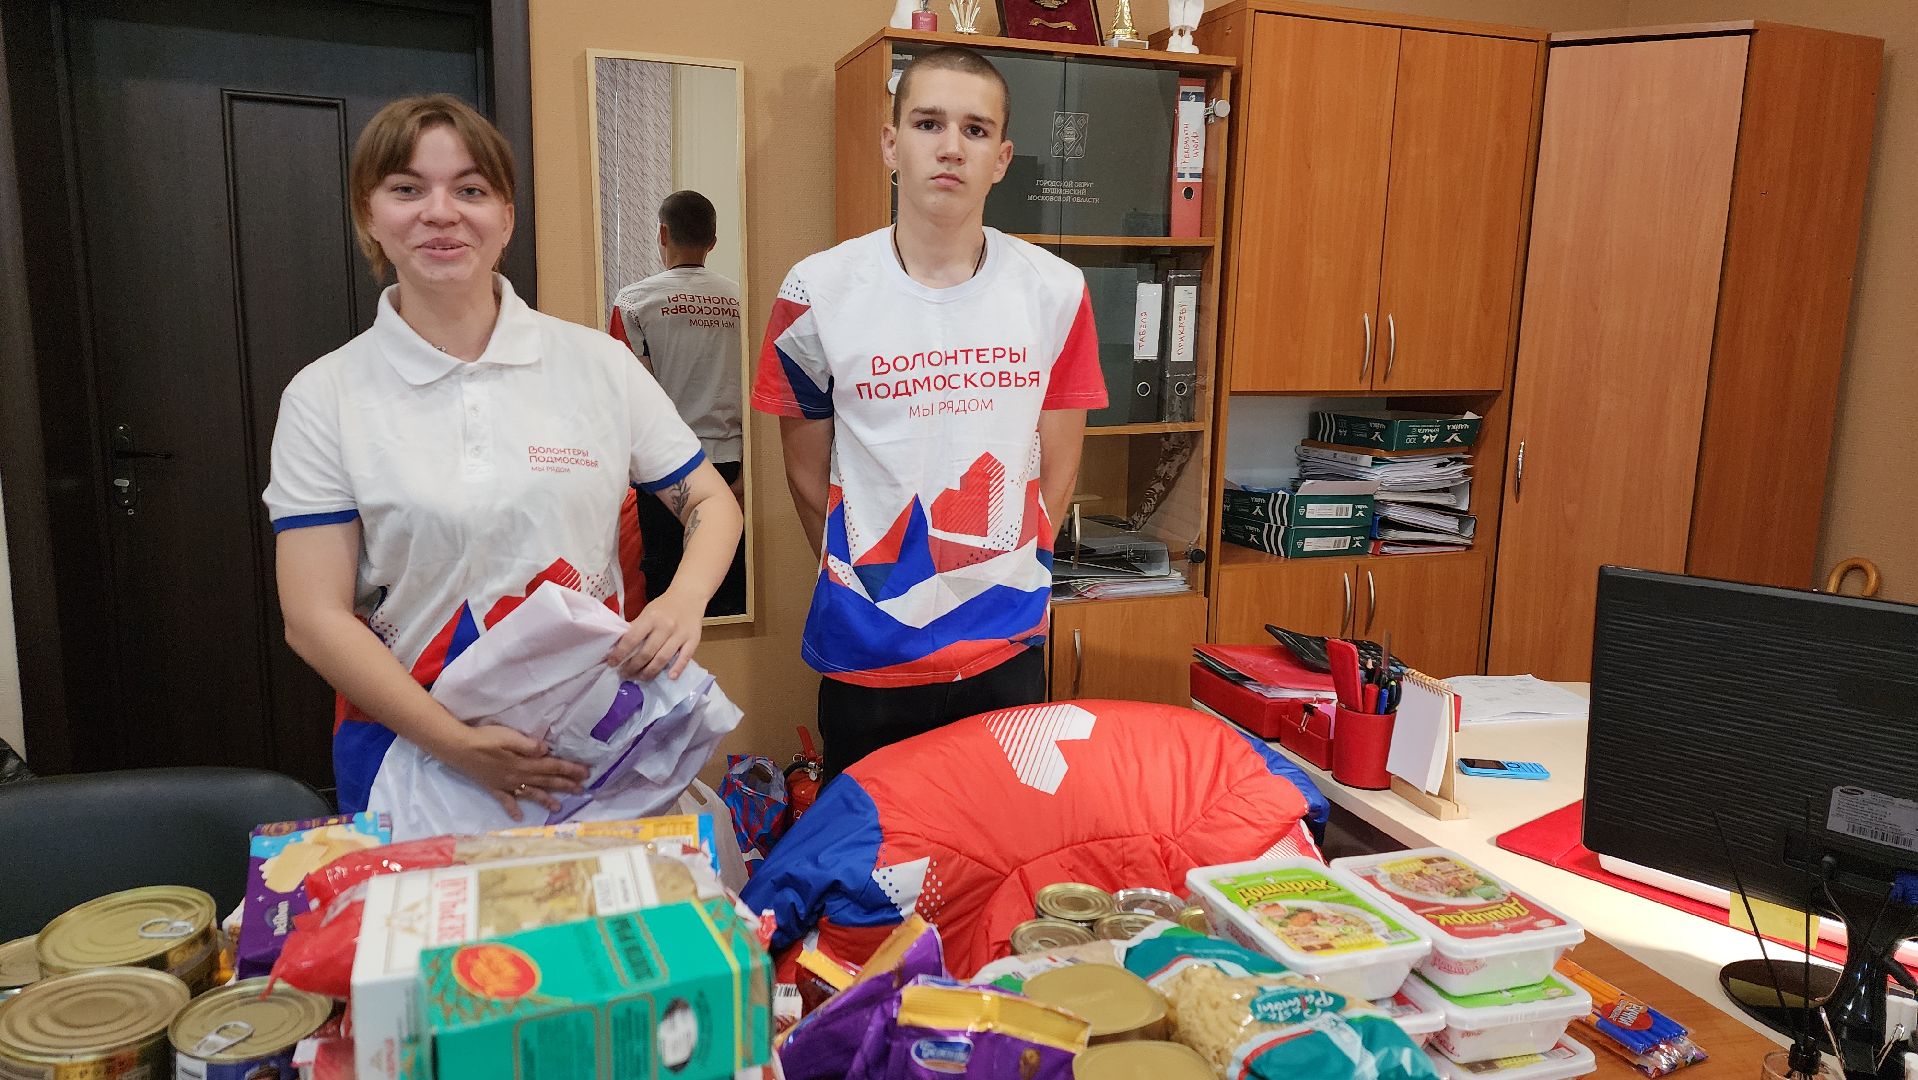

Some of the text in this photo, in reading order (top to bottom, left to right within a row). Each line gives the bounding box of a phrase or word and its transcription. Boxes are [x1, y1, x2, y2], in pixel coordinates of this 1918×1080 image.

[871, 346, 1028, 376] ВОЛОНТЕРЫ
[855, 370, 1041, 401] ПОДМОСКОВЬЯ
[908, 398, 994, 419] МЫ РЯДОМ
[1446, 422, 1470, 432] ЧАЙКА
[528, 445, 589, 457] ВОЛОНТЕРЫ
[529, 455, 599, 468] ПОДМОСКОВЬЯ
[1236, 879, 1342, 907] Доширак
[1426, 897, 1531, 927] Доширак
